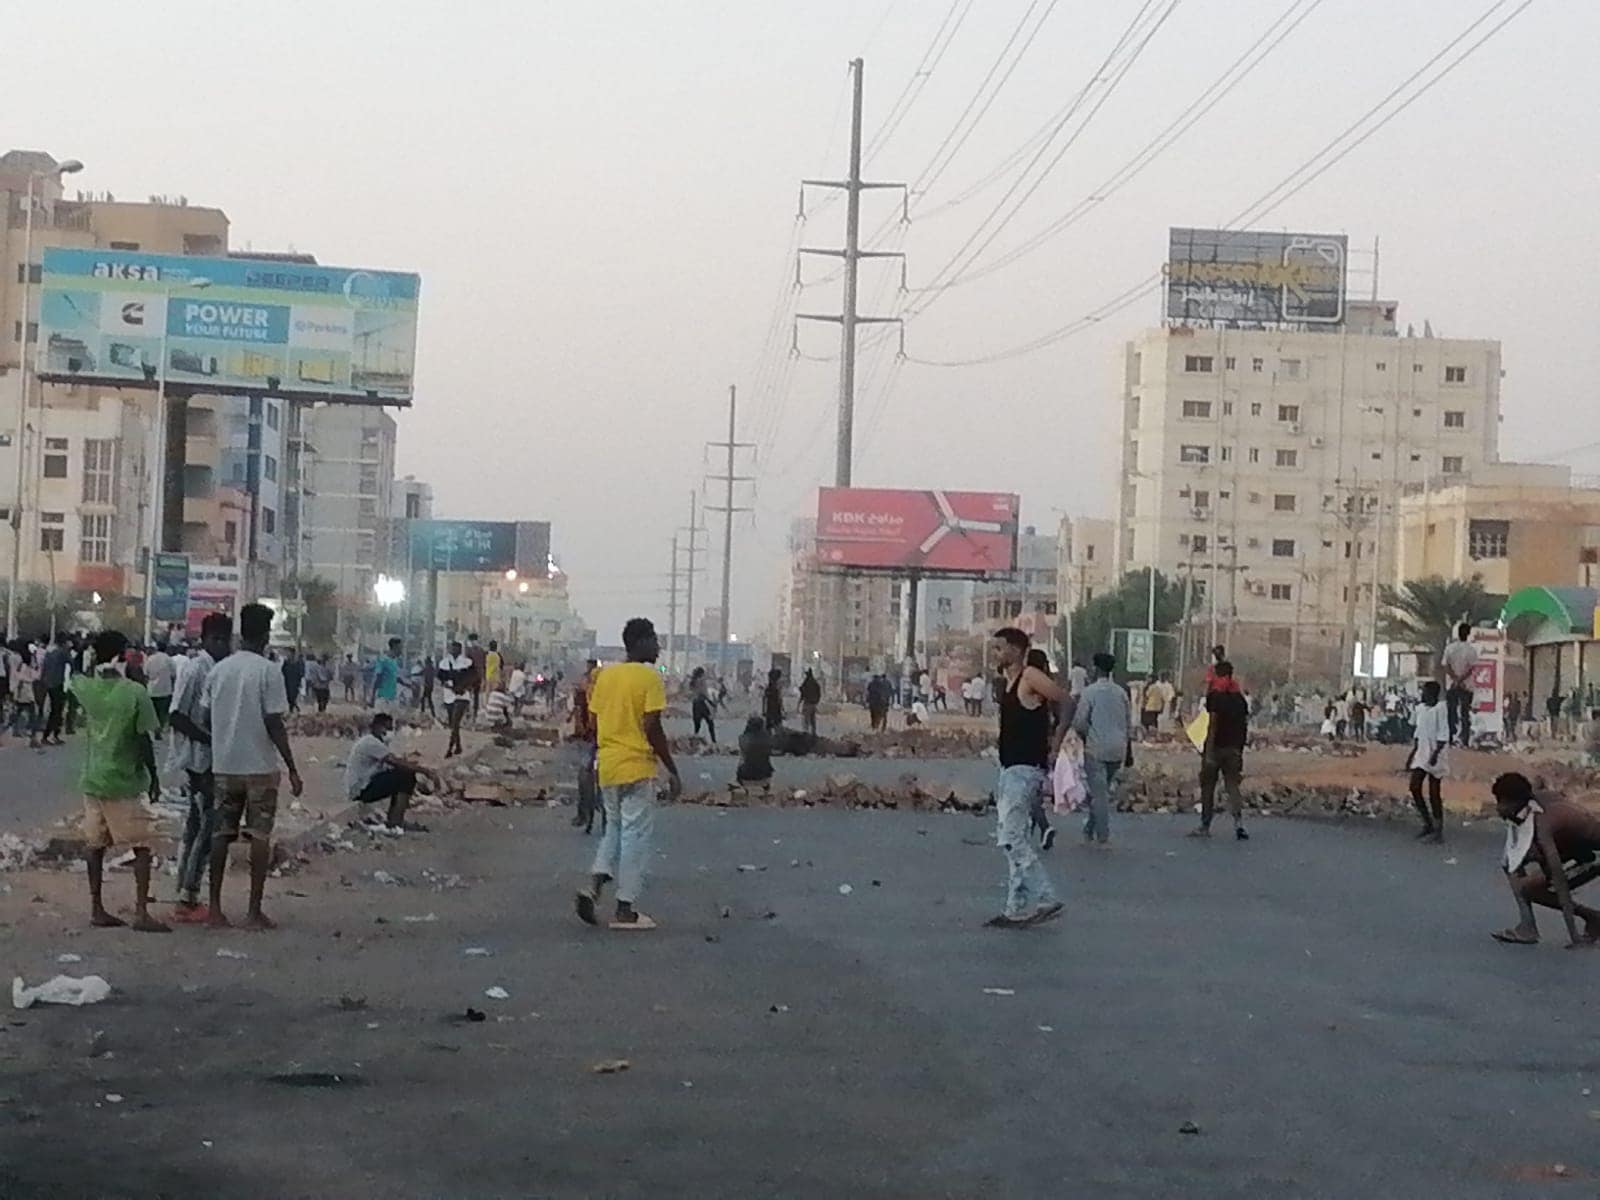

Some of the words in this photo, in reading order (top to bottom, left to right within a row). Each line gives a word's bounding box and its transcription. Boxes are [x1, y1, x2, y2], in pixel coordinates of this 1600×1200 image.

[93, 261, 159, 281] aksa
[185, 303, 268, 327] POWER
[832, 511, 865, 524] KDK
